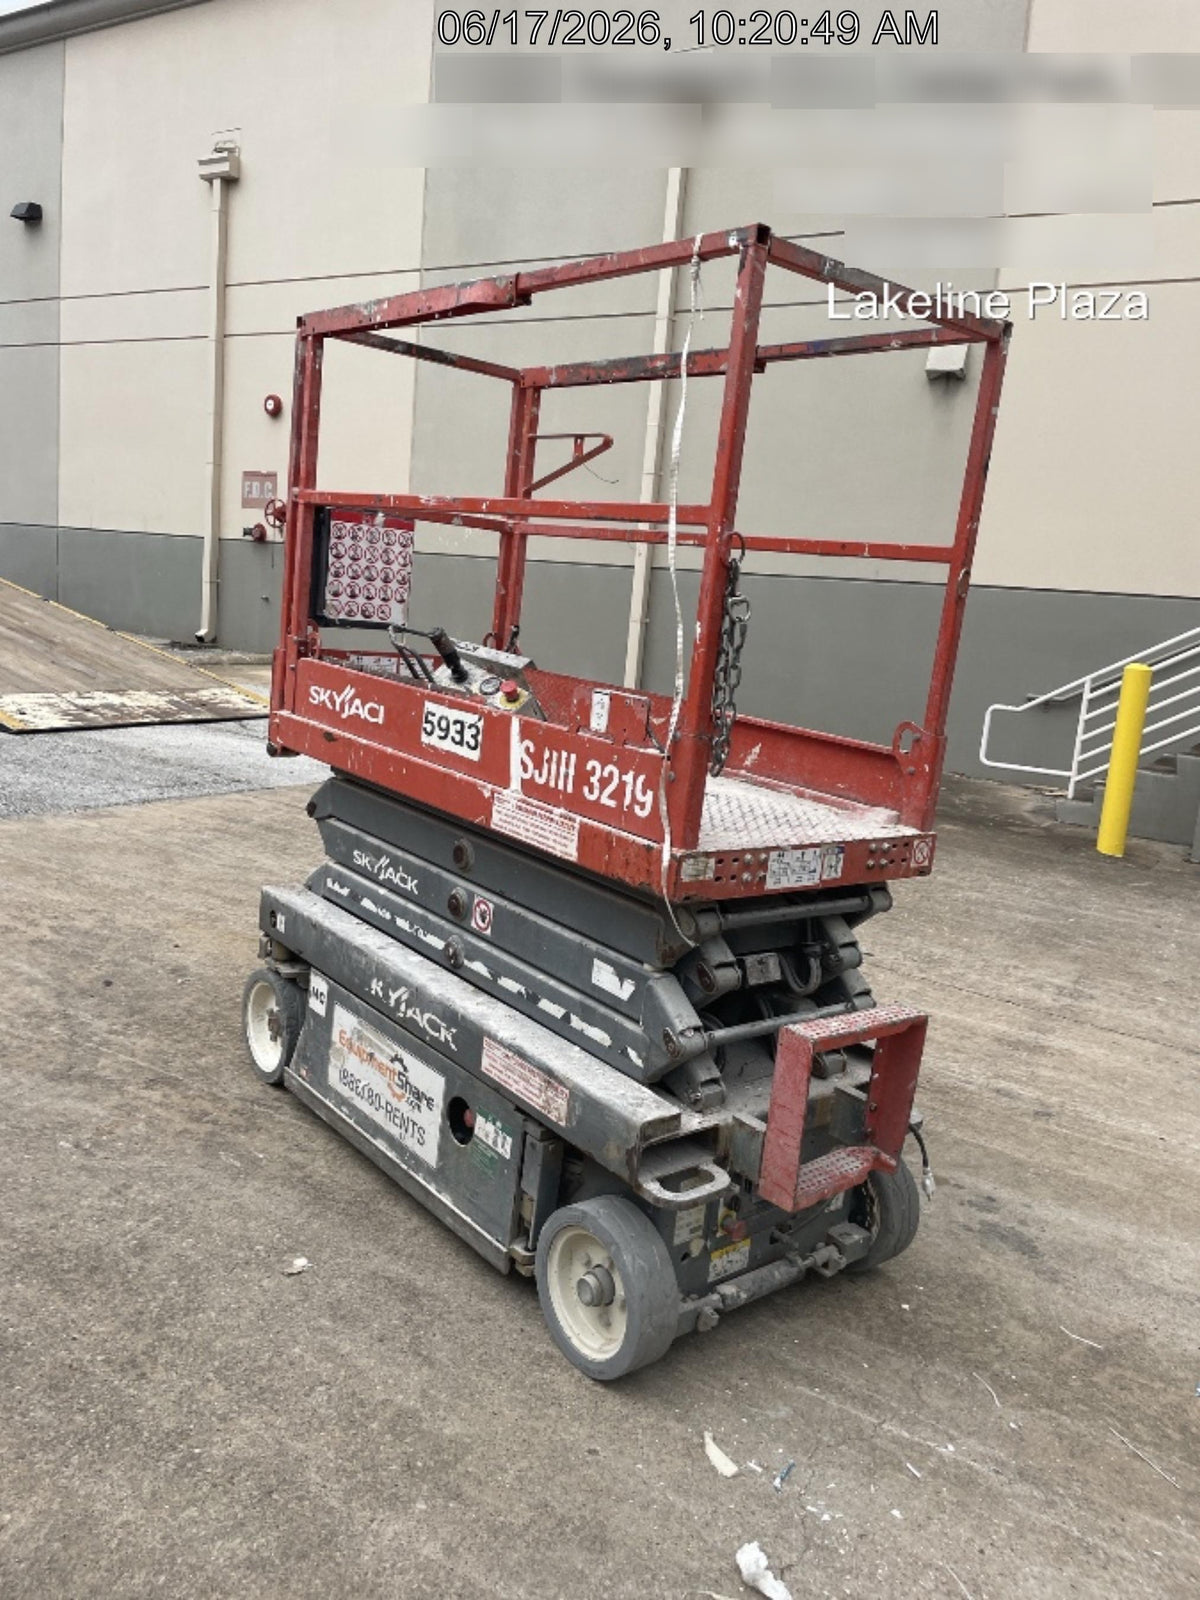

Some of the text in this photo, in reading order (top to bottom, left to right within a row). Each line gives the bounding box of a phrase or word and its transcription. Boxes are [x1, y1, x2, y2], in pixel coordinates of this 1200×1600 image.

[422, 710, 481, 751] 5933
[582, 759, 654, 818] 3219
[353, 849, 419, 895] SKYJACK
